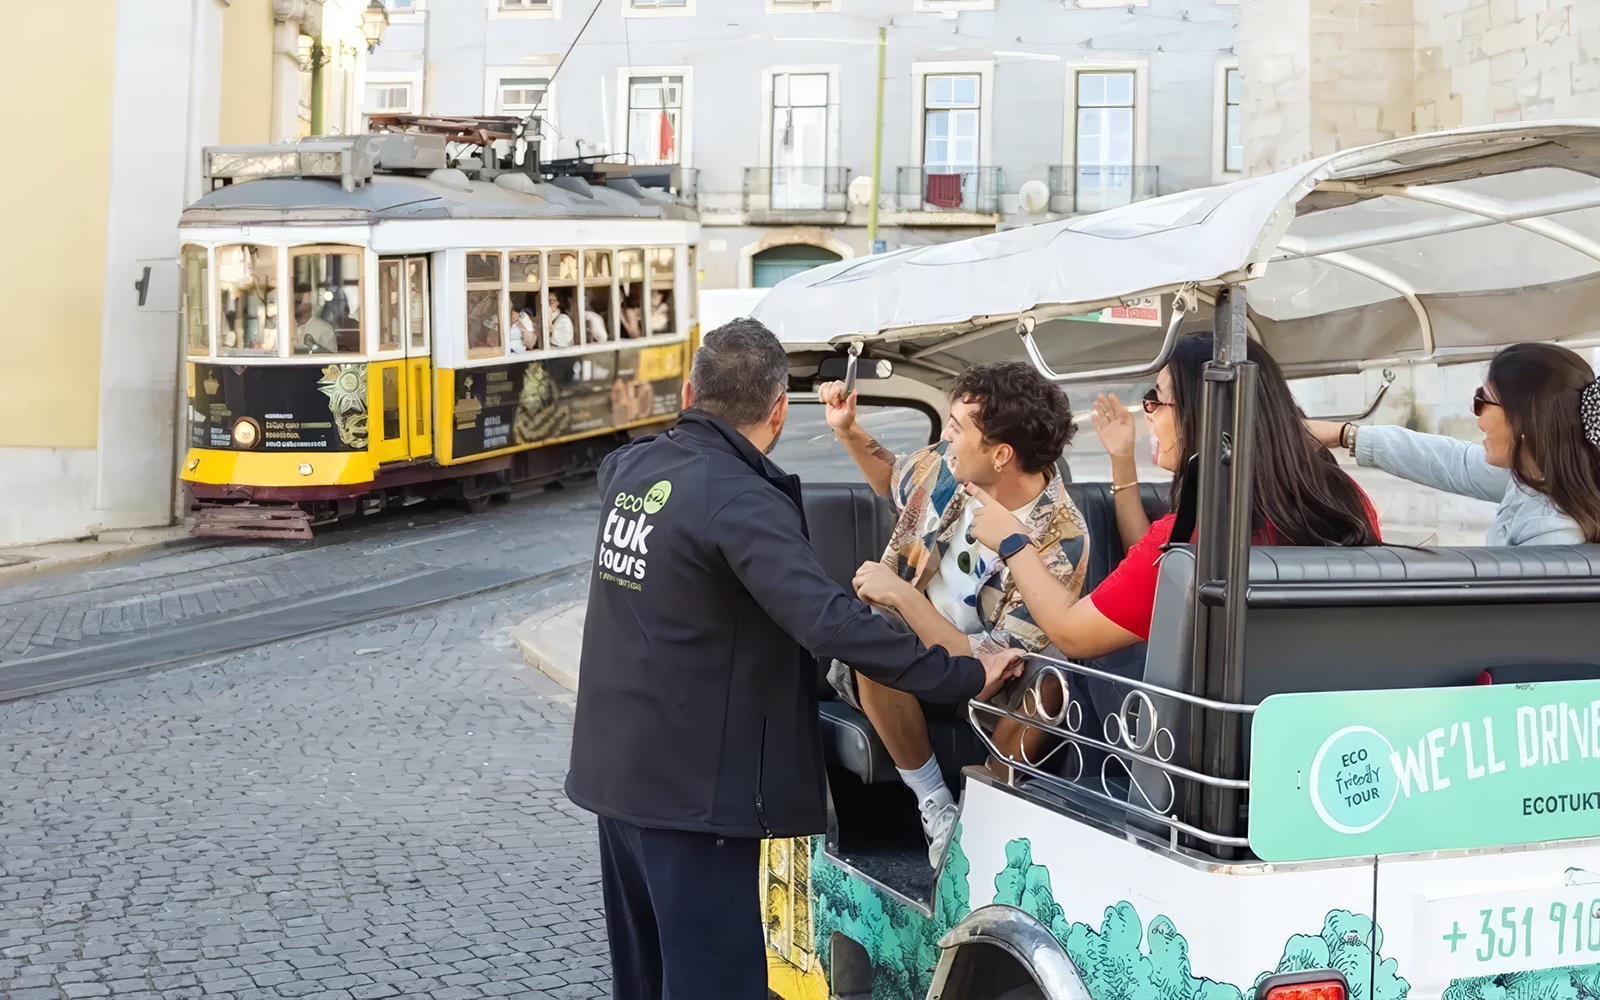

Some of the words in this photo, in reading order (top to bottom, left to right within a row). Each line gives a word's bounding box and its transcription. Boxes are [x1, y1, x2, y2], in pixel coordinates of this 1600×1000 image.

[614, 492, 643, 512] eco
[603, 508, 654, 555] tuk
[598, 542, 647, 580] tours
[1341, 748, 1368, 768] ECO
[1389, 716, 1506, 798] WE'LL
[1344, 787, 1380, 808] TOUR
